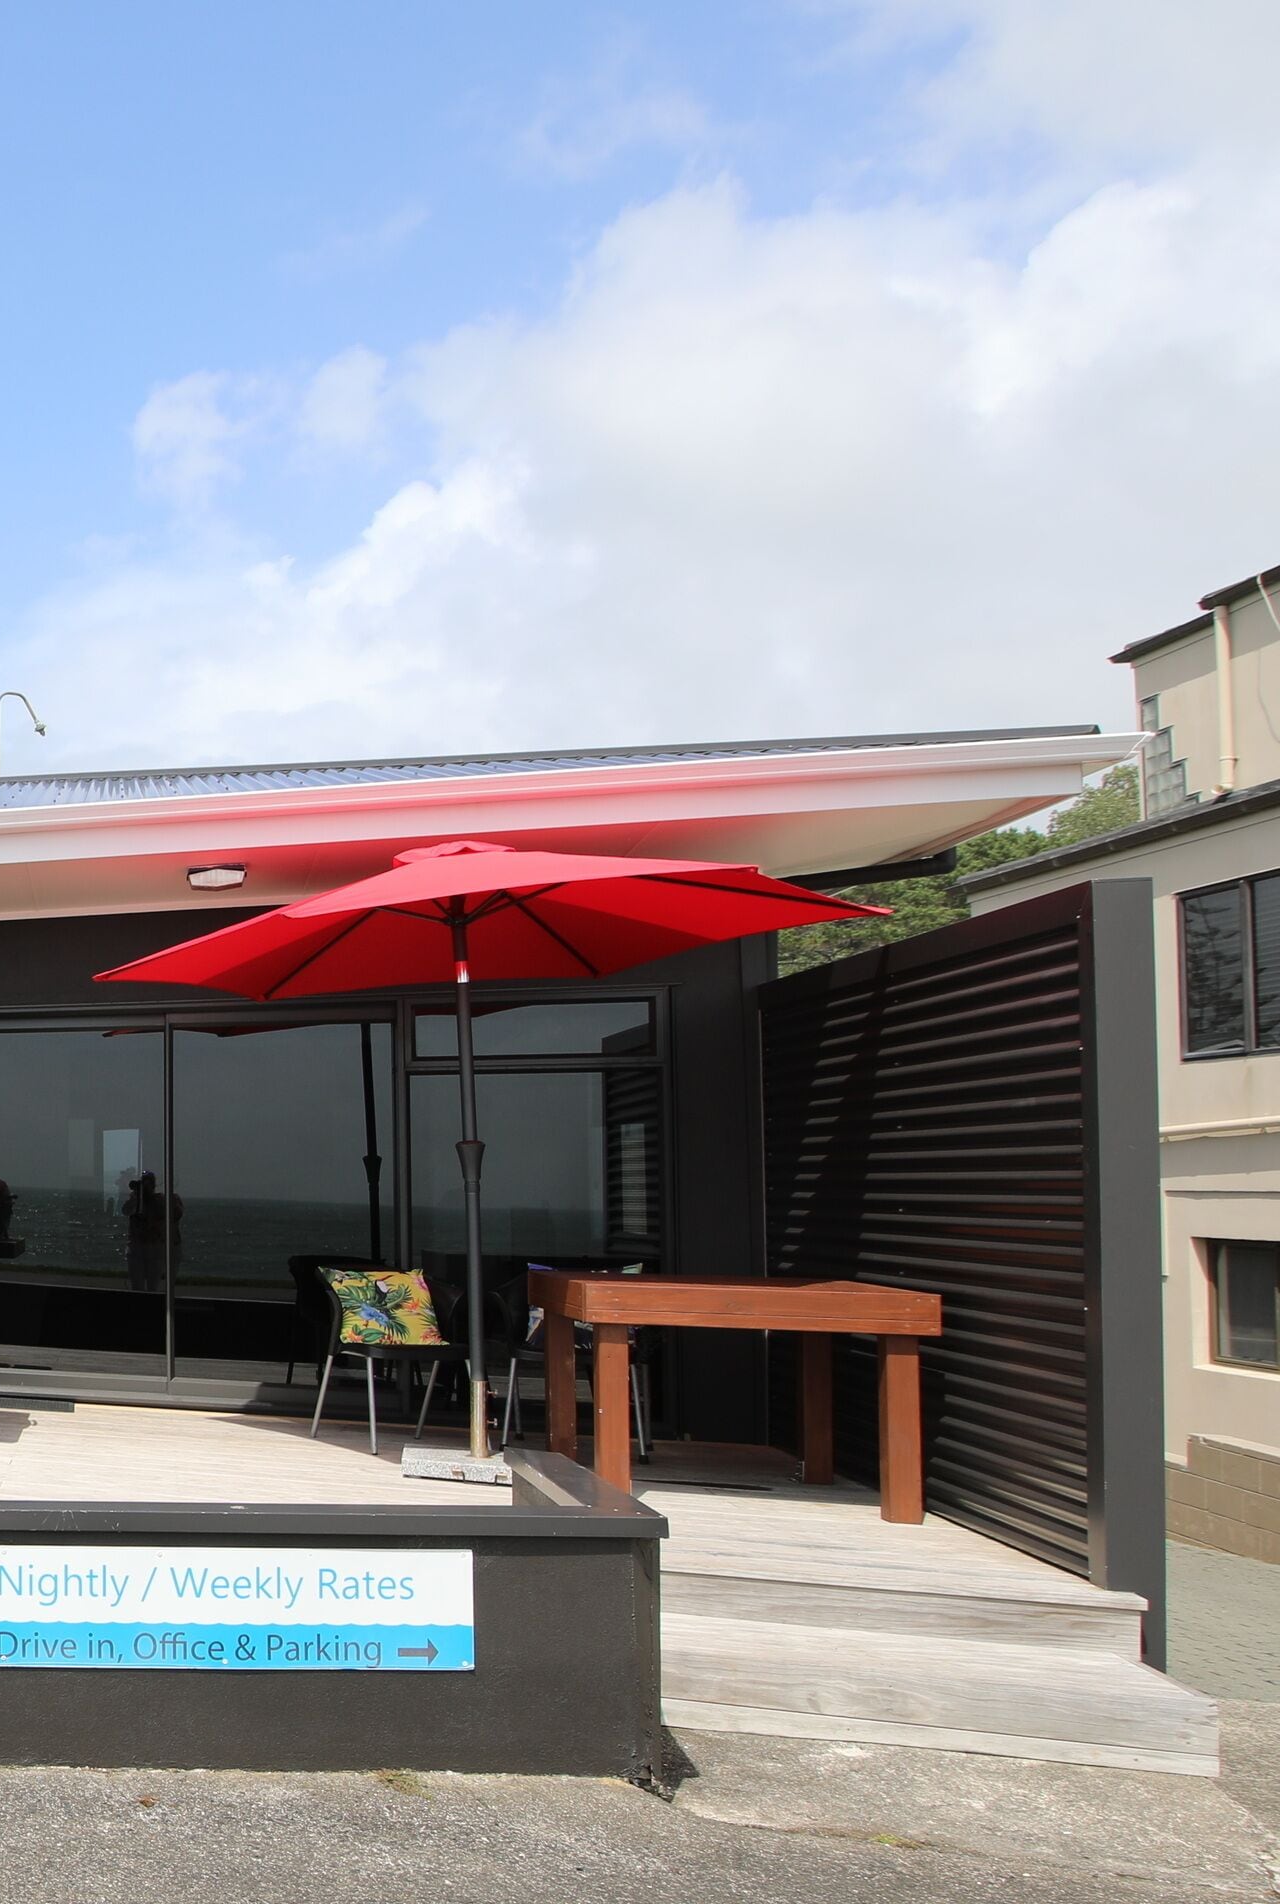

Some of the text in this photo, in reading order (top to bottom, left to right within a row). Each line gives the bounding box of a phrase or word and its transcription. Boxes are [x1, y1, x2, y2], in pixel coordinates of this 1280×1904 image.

[141, 1567, 158, 1602] /
[170, 1566, 304, 1609] Weekly
[318, 1568, 415, 1600] Rates
[88, 1632, 124, 1663] in,
[133, 1632, 225, 1661] Office
[234, 1633, 257, 1662] &
[267, 1634, 382, 1668] Parking
